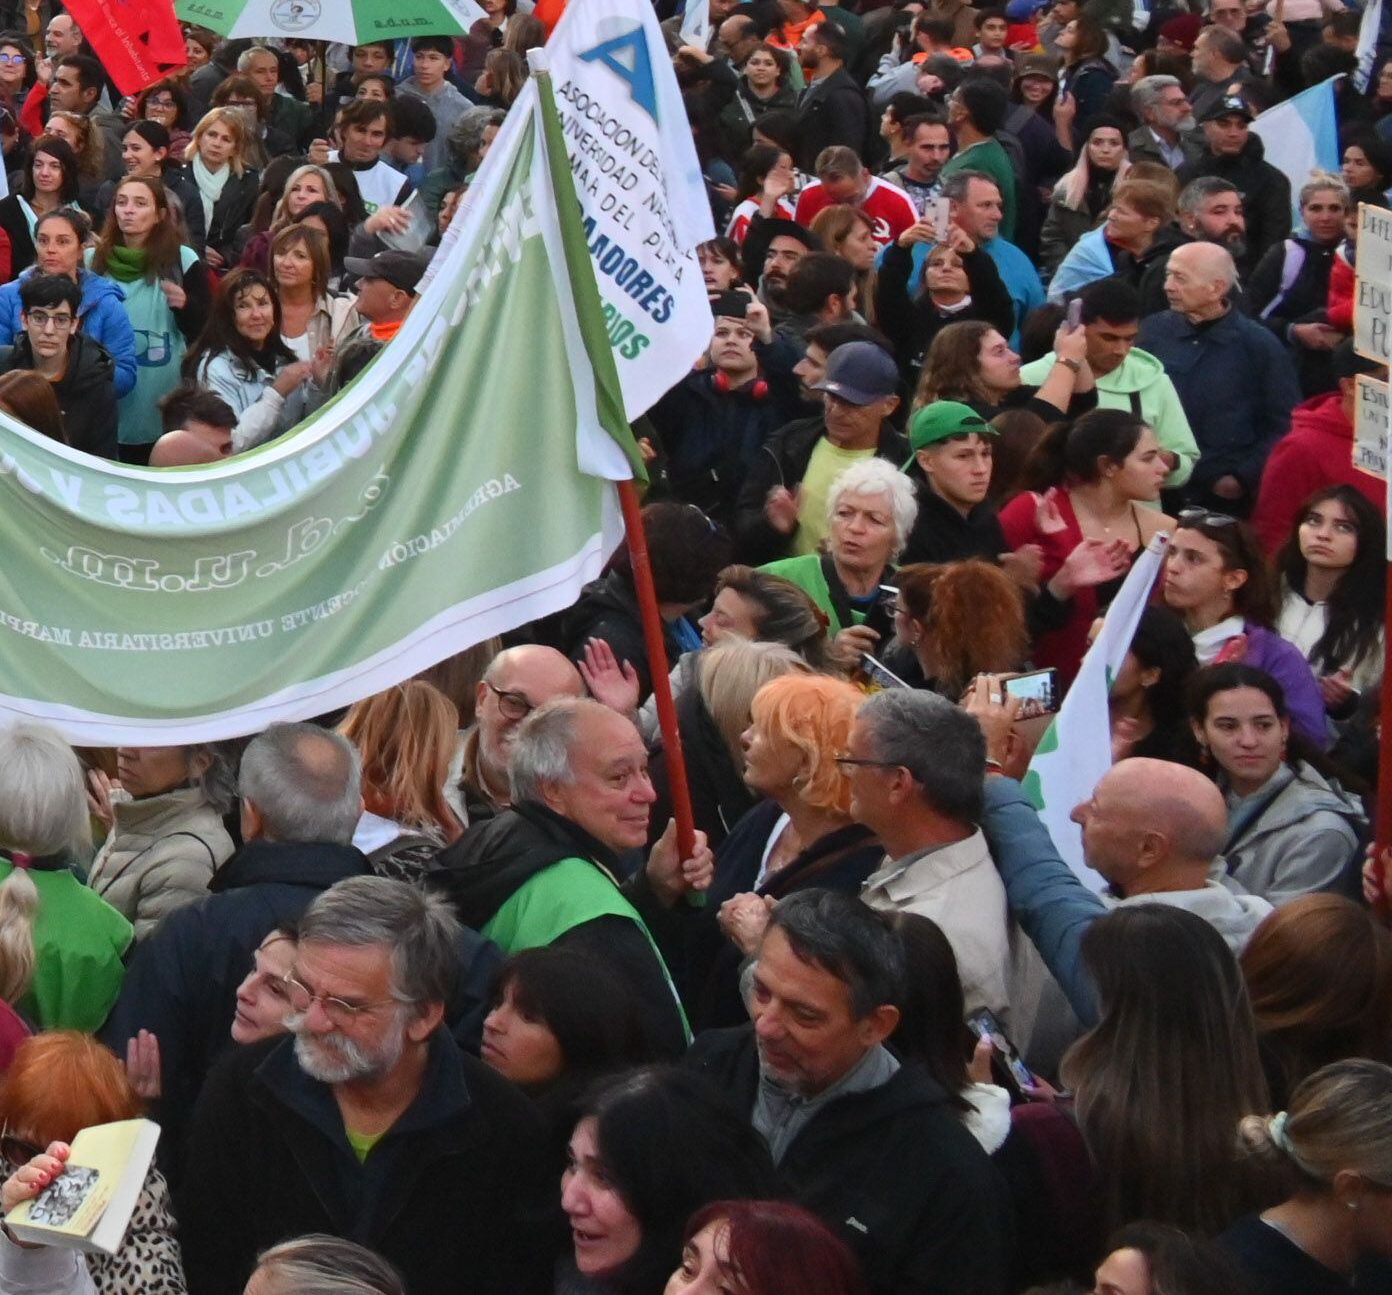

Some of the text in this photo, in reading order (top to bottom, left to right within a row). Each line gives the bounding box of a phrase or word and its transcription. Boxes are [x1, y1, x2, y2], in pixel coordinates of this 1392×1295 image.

[557, 80, 644, 158] ASOCIACION
[558, 110, 638, 191] NIVERSIDAD
[601, 194, 636, 232] DEL
